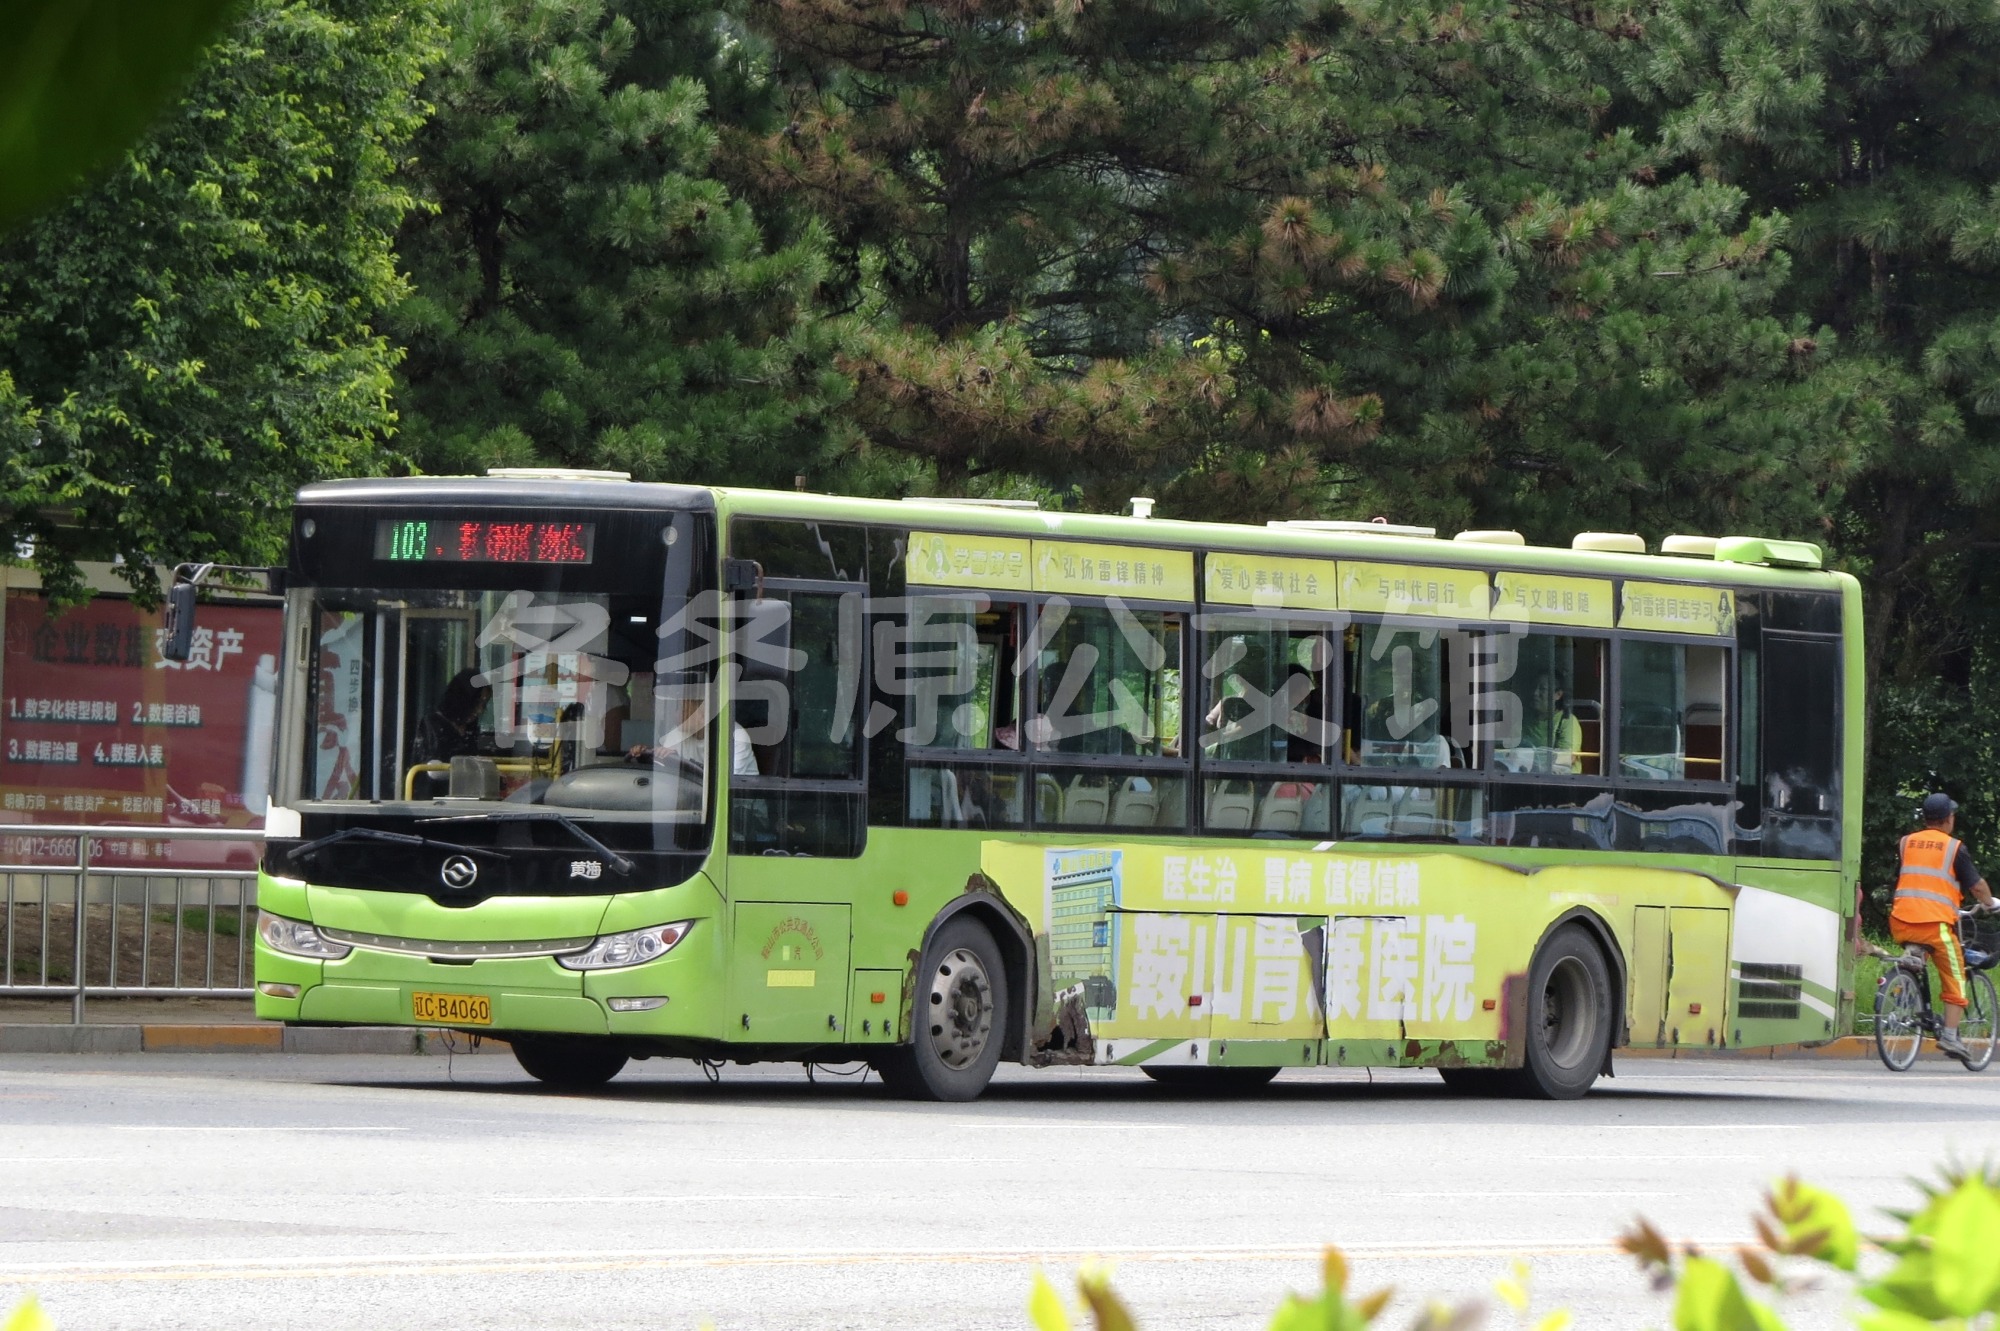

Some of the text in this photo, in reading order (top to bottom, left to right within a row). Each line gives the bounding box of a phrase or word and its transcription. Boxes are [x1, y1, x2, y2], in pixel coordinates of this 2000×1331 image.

[390, 521, 428, 560] 103
[953, 548, 1022, 578] 学雷锋号
[1063, 557, 1164, 587] 弘扬雷锋精神
[1220, 567, 1318, 596] 爱心奉献社会
[1378, 577, 1455, 605] 与时代同行
[1515, 585, 1590, 614] 与文明相随
[1631, 597, 1714, 622] 向雷锋同志学习
[10, 697, 200, 725] 1.数字化转型规划 2.数据咨询
[9, 738, 163, 765] 3.数据治理 4.数据入表
[4, 793, 46, 811] 明确方向
[122, 796, 163, 814] 挖掘价值
[570, 860, 602, 880] 黄海
[1163, 856, 1420, 907] 医生治 胃病 值得信赖
[1130, 911, 1476, 1022] 鞍山胃康医院
